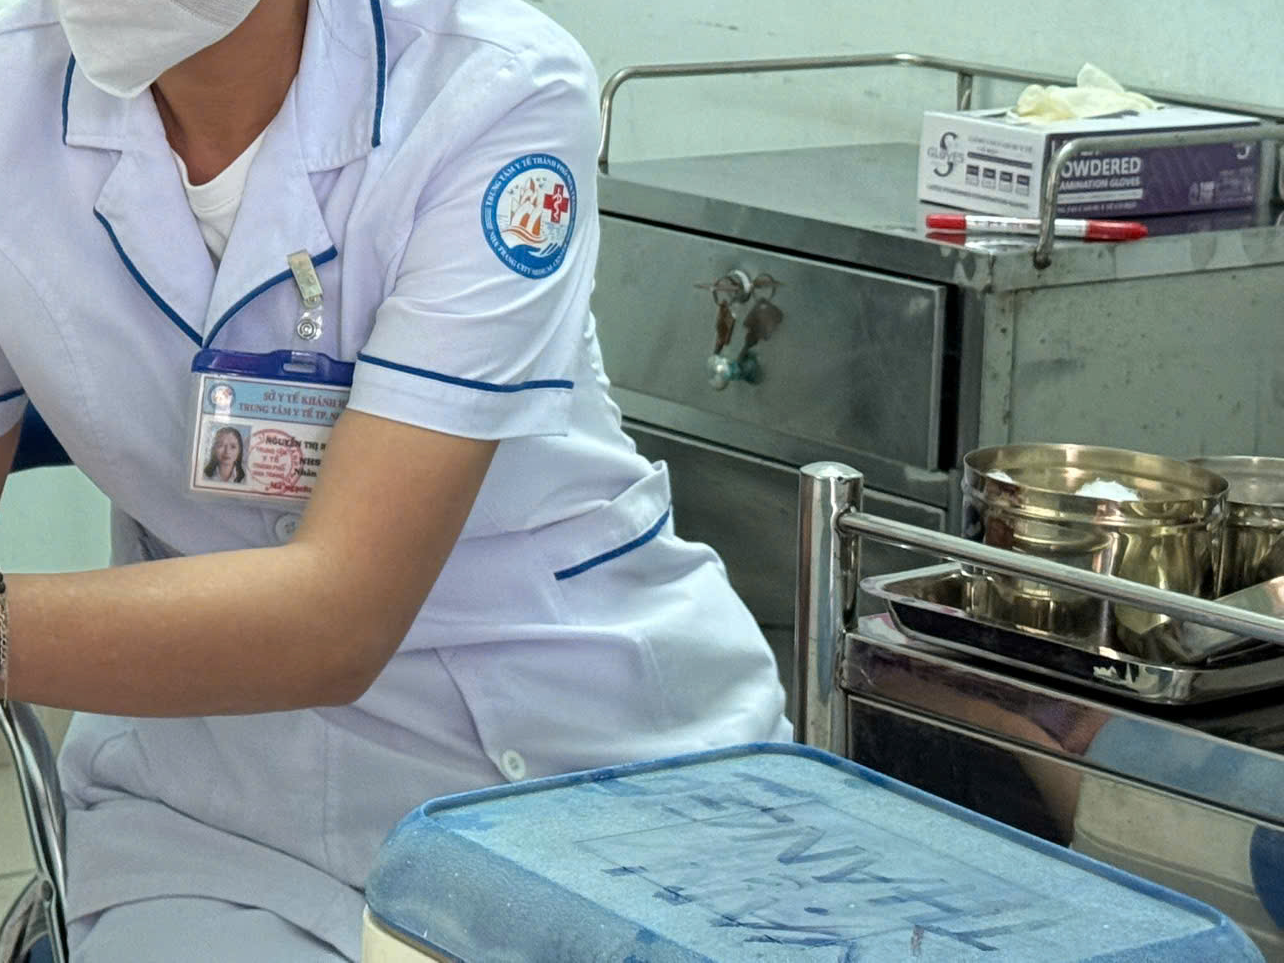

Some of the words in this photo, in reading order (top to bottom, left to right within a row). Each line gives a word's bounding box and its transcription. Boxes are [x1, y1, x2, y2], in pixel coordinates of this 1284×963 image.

[1061, 156, 1143, 180] OWDERED
[1059, 178, 1109, 192] AMINATION
[263, 389, 276, 402] SỞ
[276, 391, 286, 402] Y
[286, 390, 301, 403] TẾ
[238, 403, 269, 415] TRUNG
[271, 405, 291, 417] TÂM
[292, 408, 300, 417] Y
[265, 435, 301, 448] NGUYỄN
